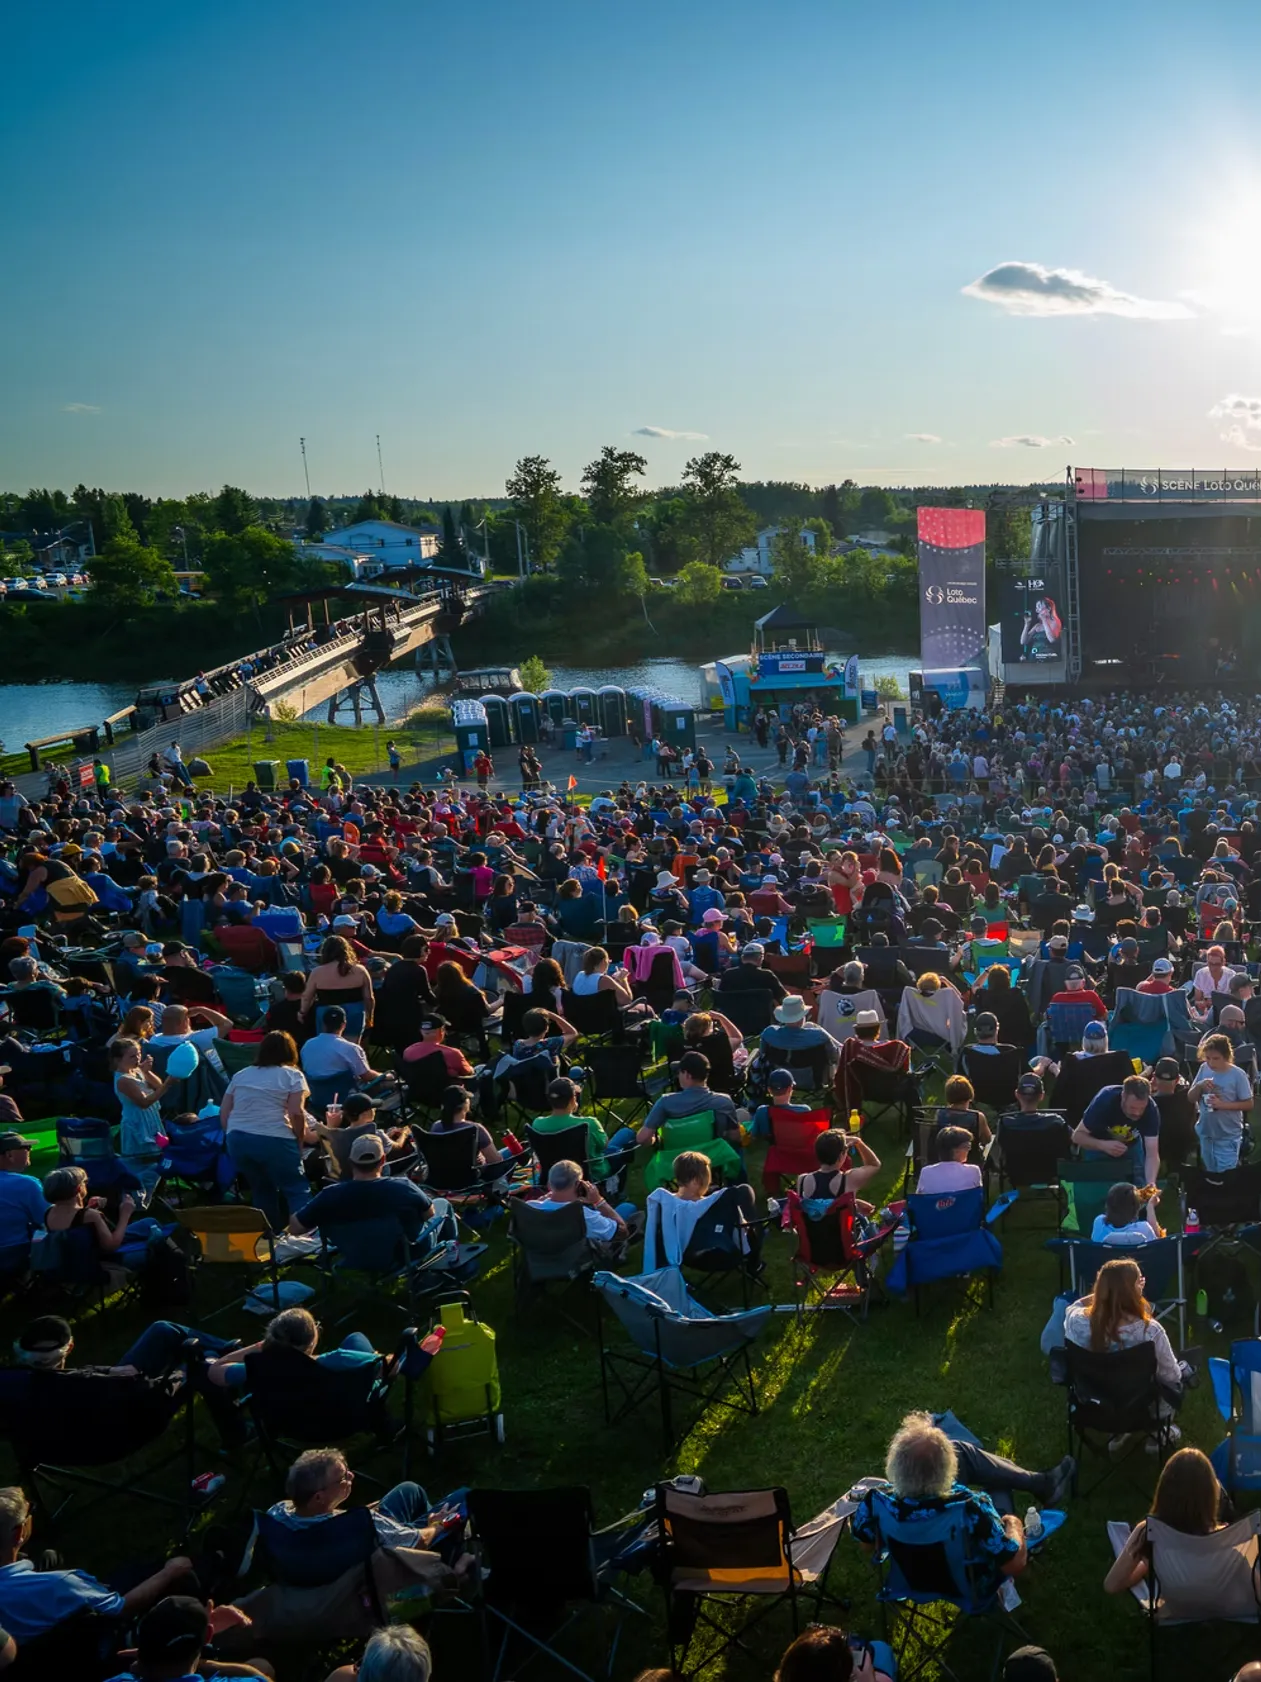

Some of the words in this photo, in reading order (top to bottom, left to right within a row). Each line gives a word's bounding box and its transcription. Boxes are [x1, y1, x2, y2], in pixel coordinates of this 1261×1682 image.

[1204, 480, 1231, 491] Loto
[947, 588, 963, 596] Loto
[946, 596, 978, 605] Québec
